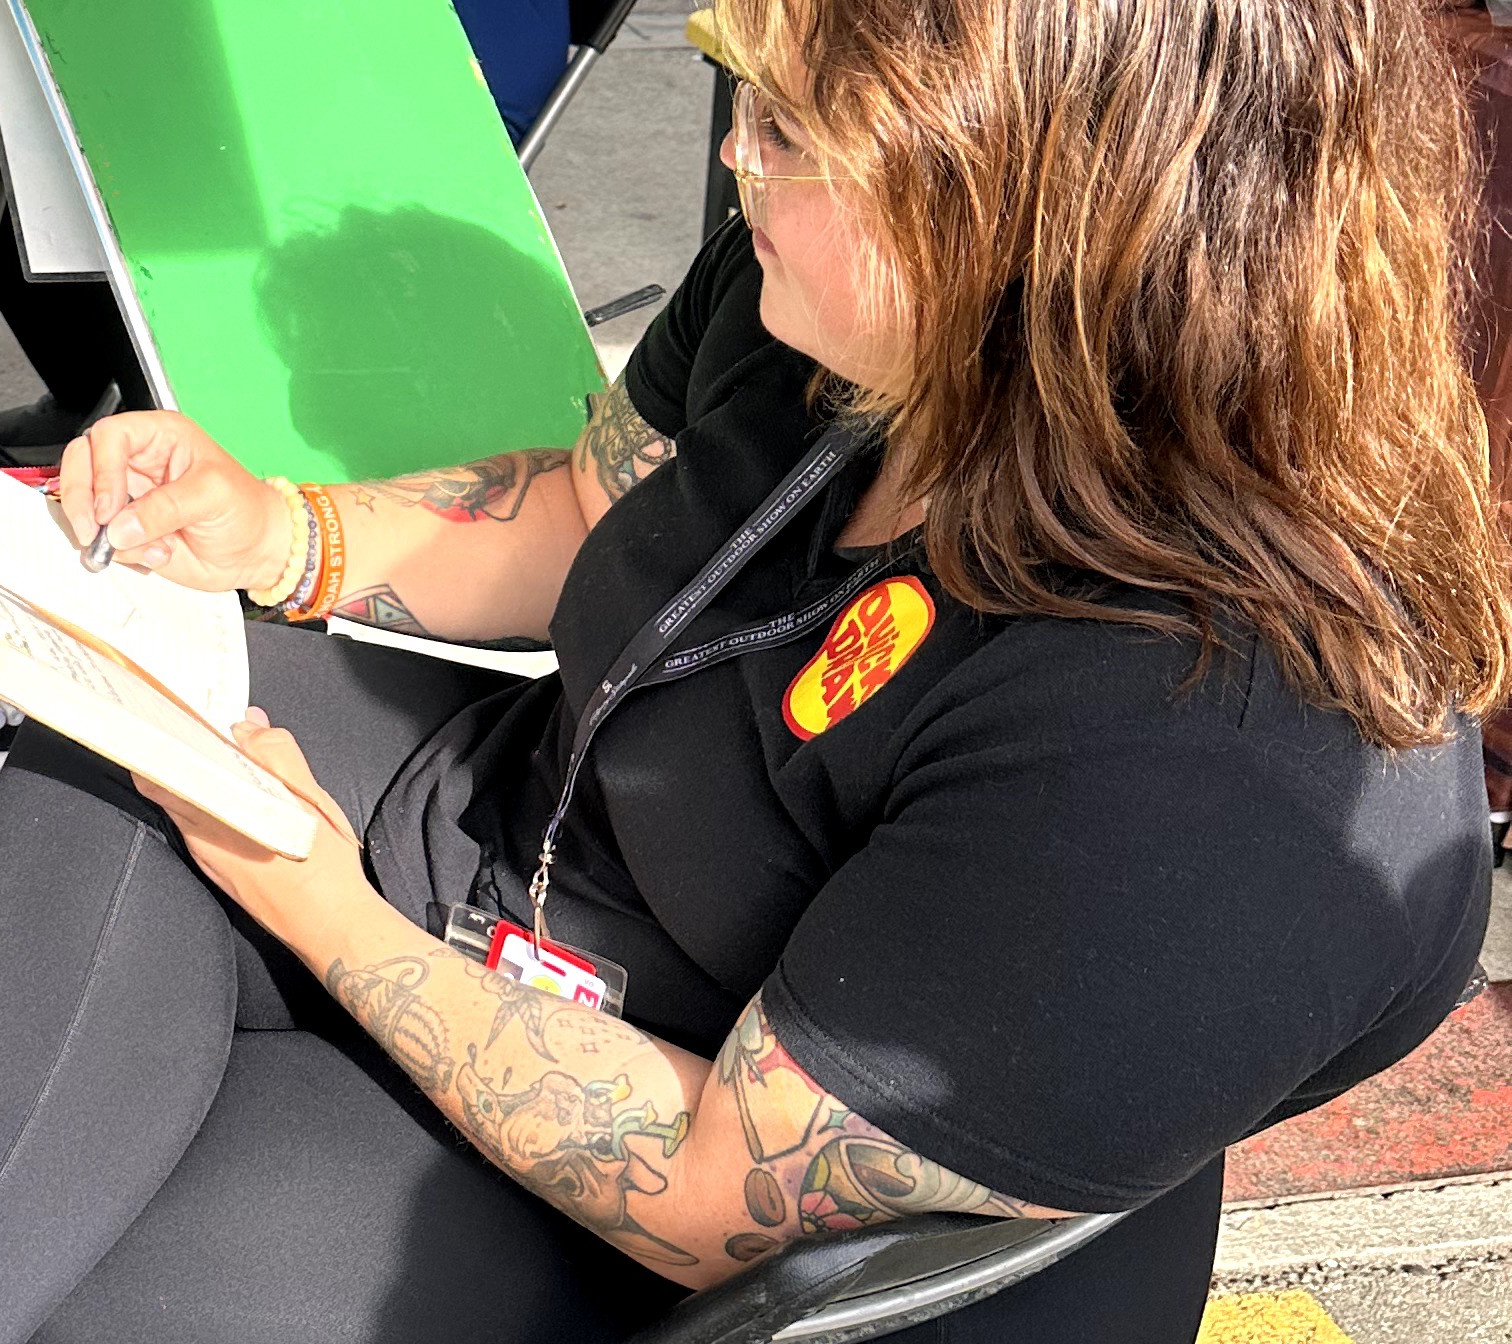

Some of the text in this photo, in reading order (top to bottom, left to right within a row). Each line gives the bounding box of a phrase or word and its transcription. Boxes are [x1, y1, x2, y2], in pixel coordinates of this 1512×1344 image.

[316, 495, 343, 567] STRONG
[658, 451, 837, 633] GREATEST OUTDOOR SHOW ON EARTH
[729, 526, 753, 550] THE
[665, 641, 727, 668] GREATEST
[727, 620, 795, 646] OUTDOOR
[768, 611, 796, 629] THE
[857, 584, 900, 703] QUICK
